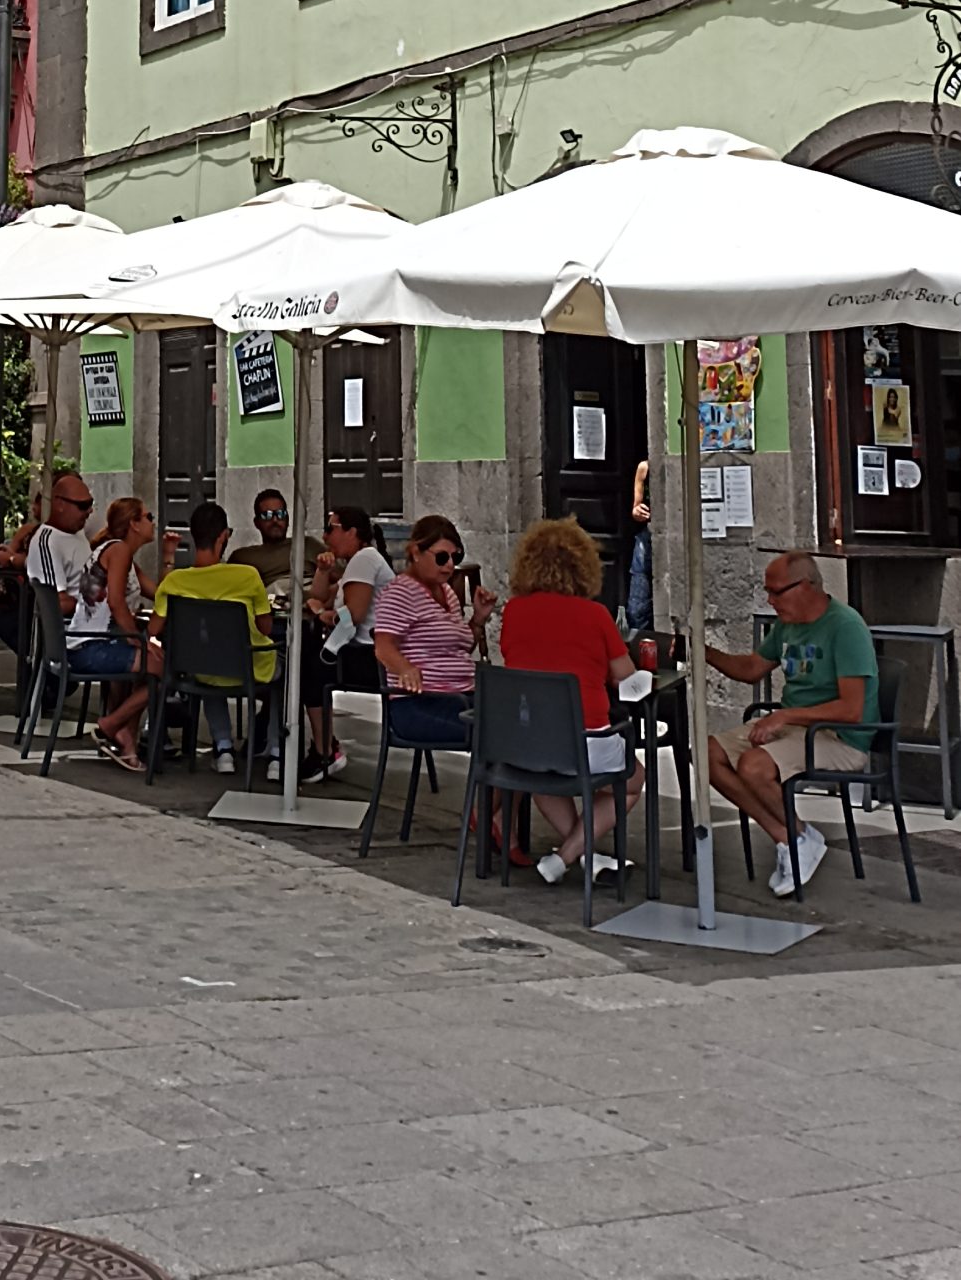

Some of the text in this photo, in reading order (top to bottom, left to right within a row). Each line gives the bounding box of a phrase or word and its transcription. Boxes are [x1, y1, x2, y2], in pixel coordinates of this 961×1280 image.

[231, 294, 322, 319] strella Galicia
[243, 367, 271, 386] CHAPLIN
